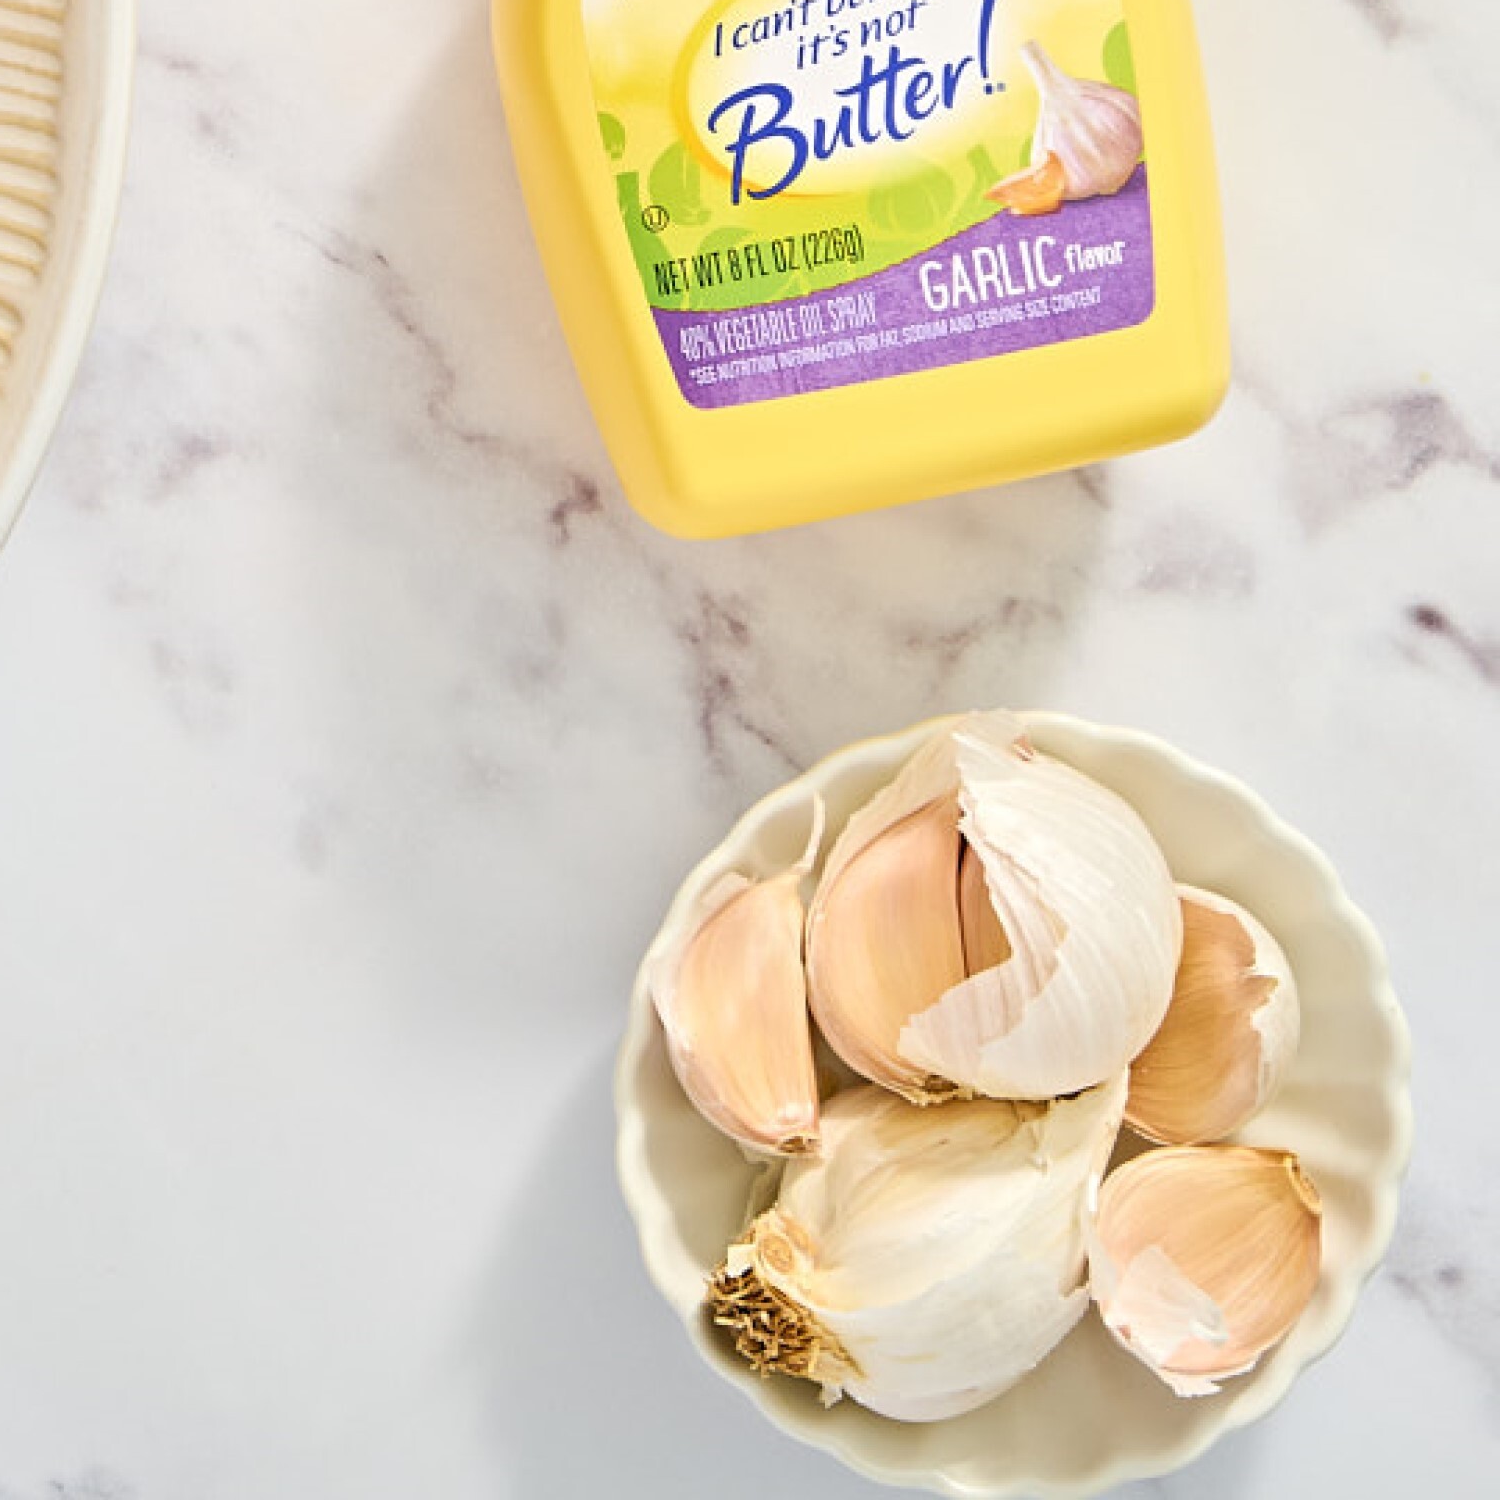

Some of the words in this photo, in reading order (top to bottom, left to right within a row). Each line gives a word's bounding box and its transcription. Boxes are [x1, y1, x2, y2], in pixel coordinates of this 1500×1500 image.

[713, 22, 723, 57] I
[797, 24, 850, 70] it's
[860, 0, 928, 47] not
[654, 258, 690, 296] NET
[692, 252, 722, 287] WT
[728, 247, 742, 281] 8
[744, 244, 769, 278] FL
[772, 236, 800, 272] OZ
[802, 222, 864, 271] (226g)
[919, 236, 1064, 311] GARLIC
[1064, 241, 1125, 272] flavor
[714, 308, 797, 354] VEGETABLE
[828, 292, 876, 332] SPRAY
